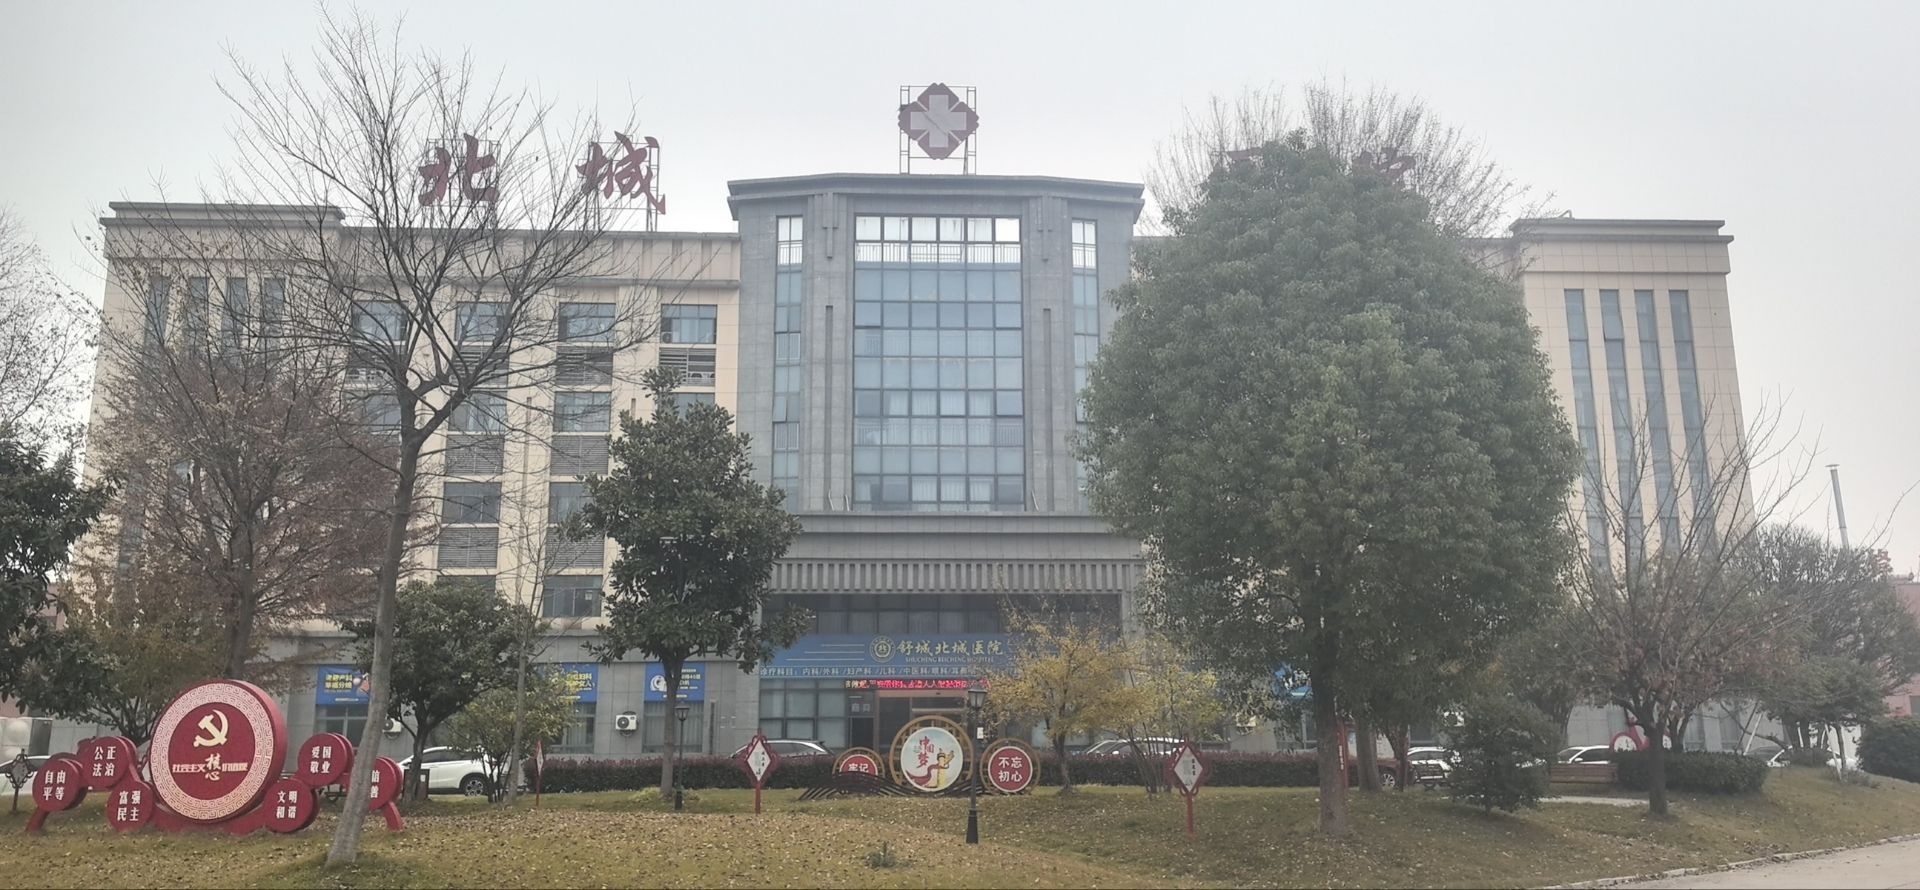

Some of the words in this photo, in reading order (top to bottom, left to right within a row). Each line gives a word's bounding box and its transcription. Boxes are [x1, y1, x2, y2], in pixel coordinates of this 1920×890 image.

[898, 640, 1004, 656] 舒城北城医院
[94, 746, 116, 760] 公正
[312, 746, 332, 759] 爱国
[916, 736, 935, 768] 中国梦
[205, 753, 221, 781] 核心
[310, 761, 330, 774] 敬业
[848, 763, 869, 773] 牢记
[998, 756, 1023, 769] 不忘
[92, 763, 115, 776] 法治
[45, 770, 66, 784] 自由
[371, 770, 380, 783] 信
[998, 770, 1023, 783] 初心
[43, 787, 65, 800] 平等
[119, 790, 141, 804] 富强
[277, 791, 298, 804] 文明
[117, 807, 139, 821] 民主
[276, 806, 297, 819] 和谐
